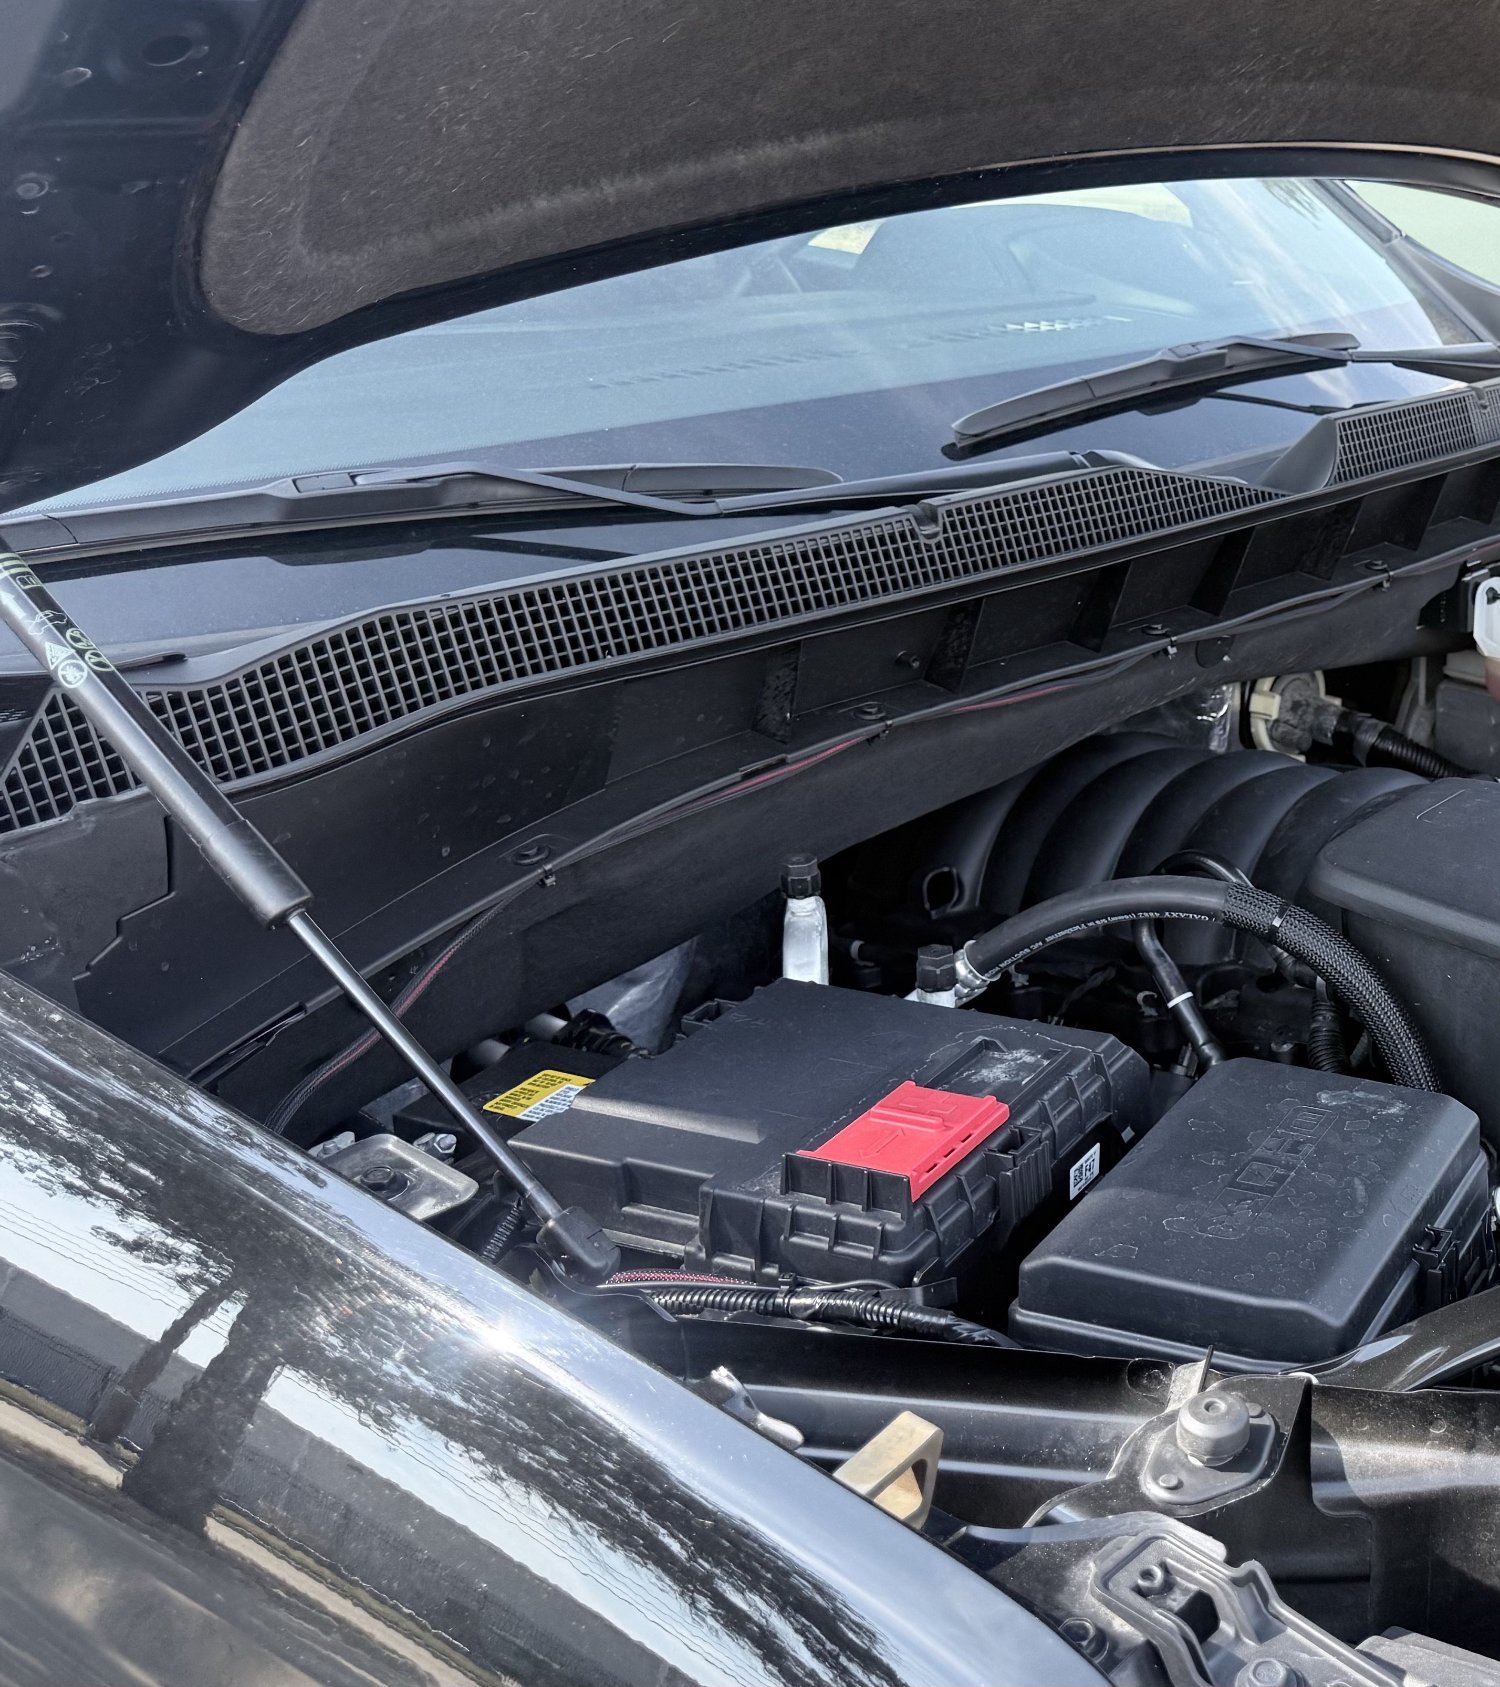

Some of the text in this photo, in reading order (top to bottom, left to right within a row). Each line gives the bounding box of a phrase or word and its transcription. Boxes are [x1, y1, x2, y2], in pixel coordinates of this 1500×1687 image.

[1164, 911, 1209, 920] GALAXY
[999, 948, 1031, 967] SUCTION
[1084, 1158, 1095, 1178] F47
